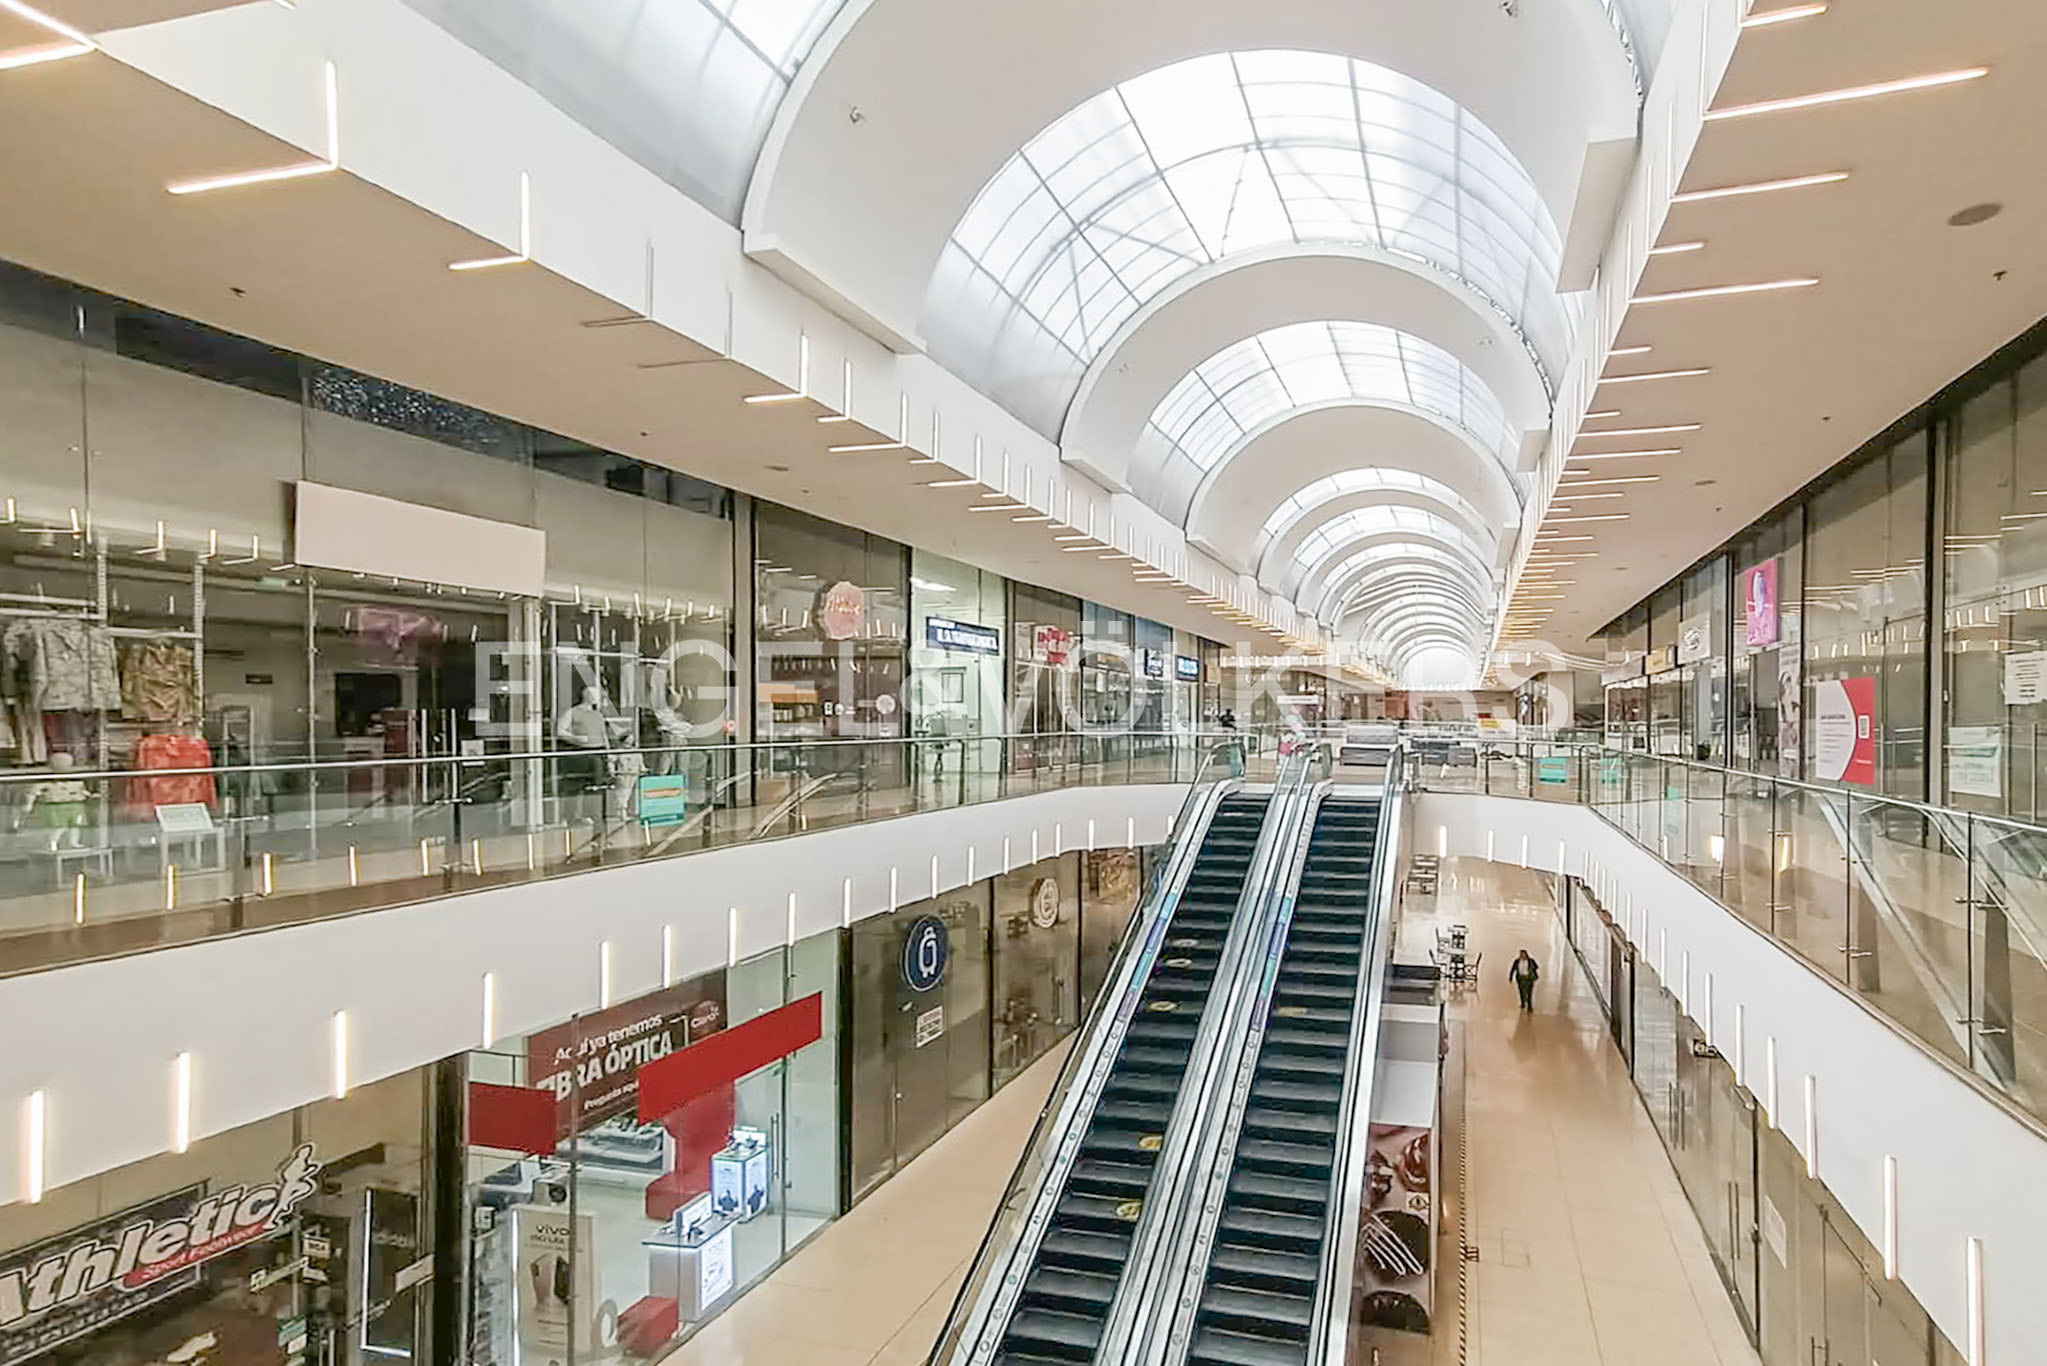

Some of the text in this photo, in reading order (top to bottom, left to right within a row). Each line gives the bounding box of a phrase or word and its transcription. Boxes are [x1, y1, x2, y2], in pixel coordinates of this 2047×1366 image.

[588, 1036, 607, 1055] ya
[607, 1014, 662, 1043] tenemos
[605, 1030, 673, 1074] ÓPTICA
[536, 1224, 570, 1236] vivo
